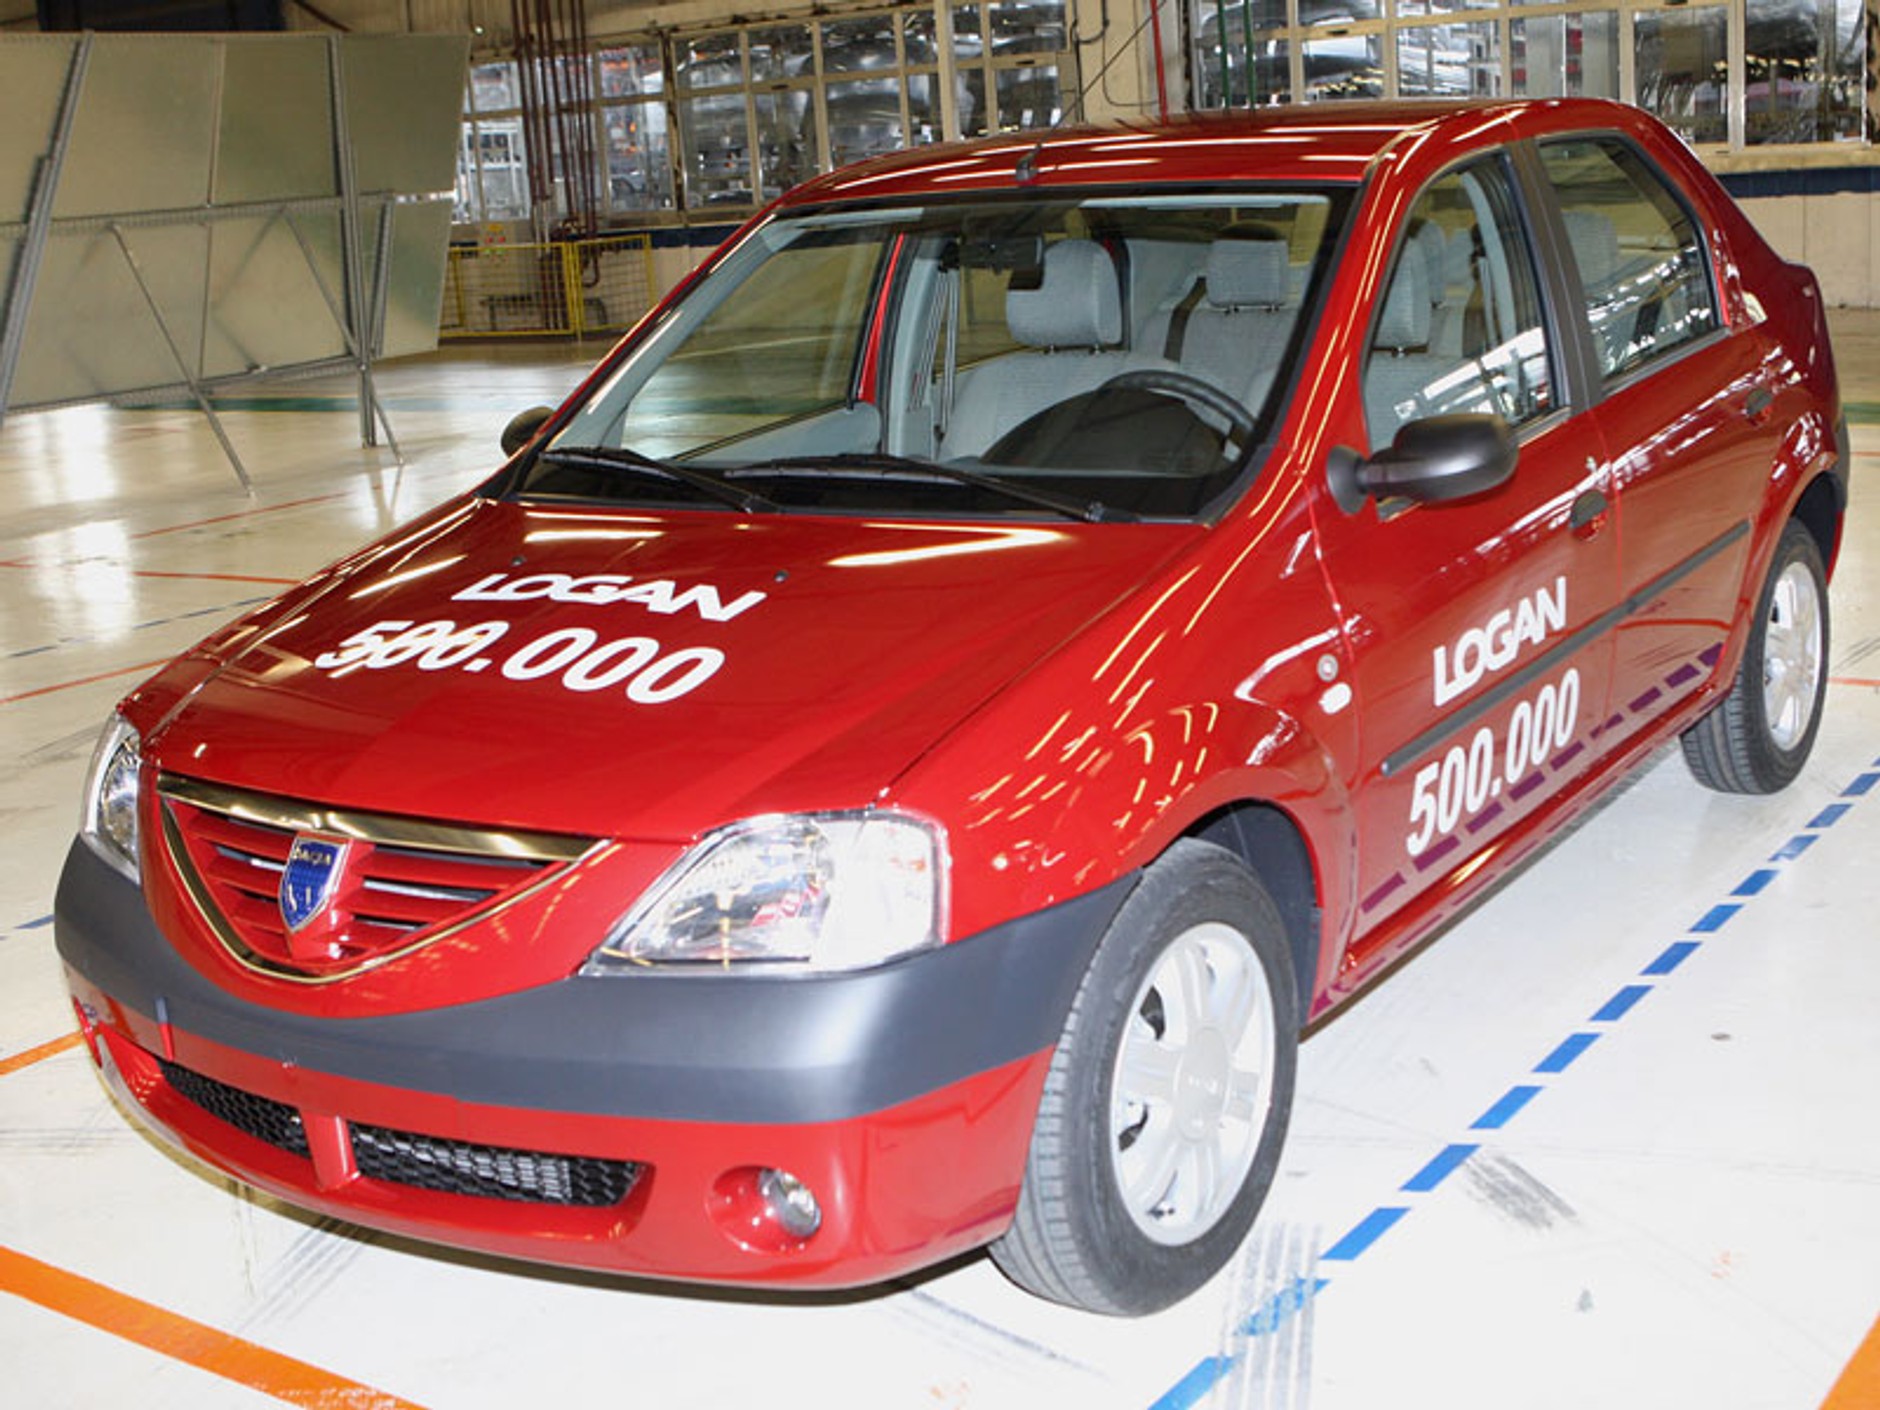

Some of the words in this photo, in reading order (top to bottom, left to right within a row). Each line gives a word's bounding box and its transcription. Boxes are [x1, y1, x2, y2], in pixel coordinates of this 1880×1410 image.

[451, 573, 766, 622] LOGAN
[1433, 576, 1567, 707] LOGAN
[314, 620, 725, 704] 500.000
[1406, 668, 1579, 855] 500.000
